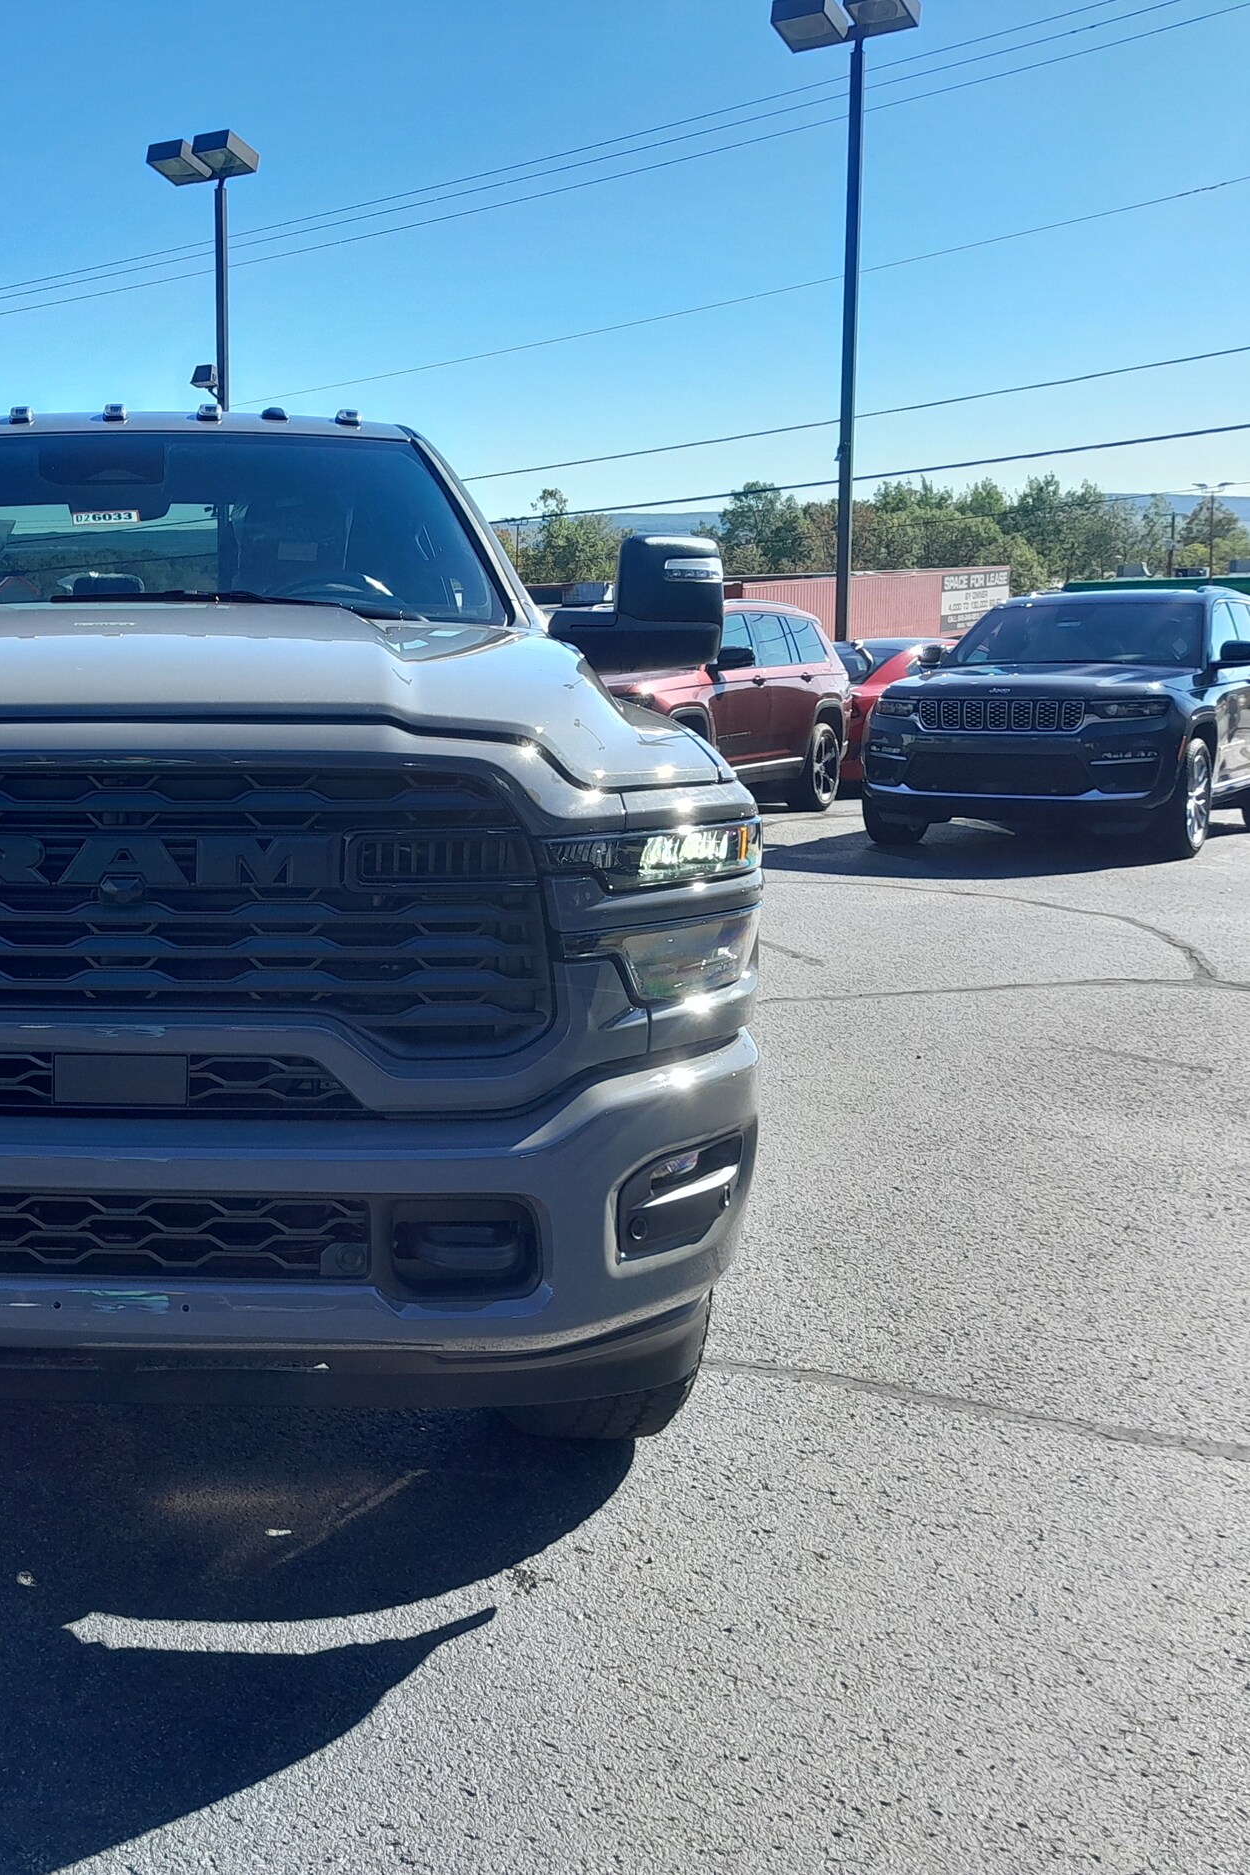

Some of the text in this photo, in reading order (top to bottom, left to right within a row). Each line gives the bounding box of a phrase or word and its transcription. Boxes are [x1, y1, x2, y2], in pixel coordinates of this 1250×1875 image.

[944, 572, 1008, 590] SPACE FOR LEASE
